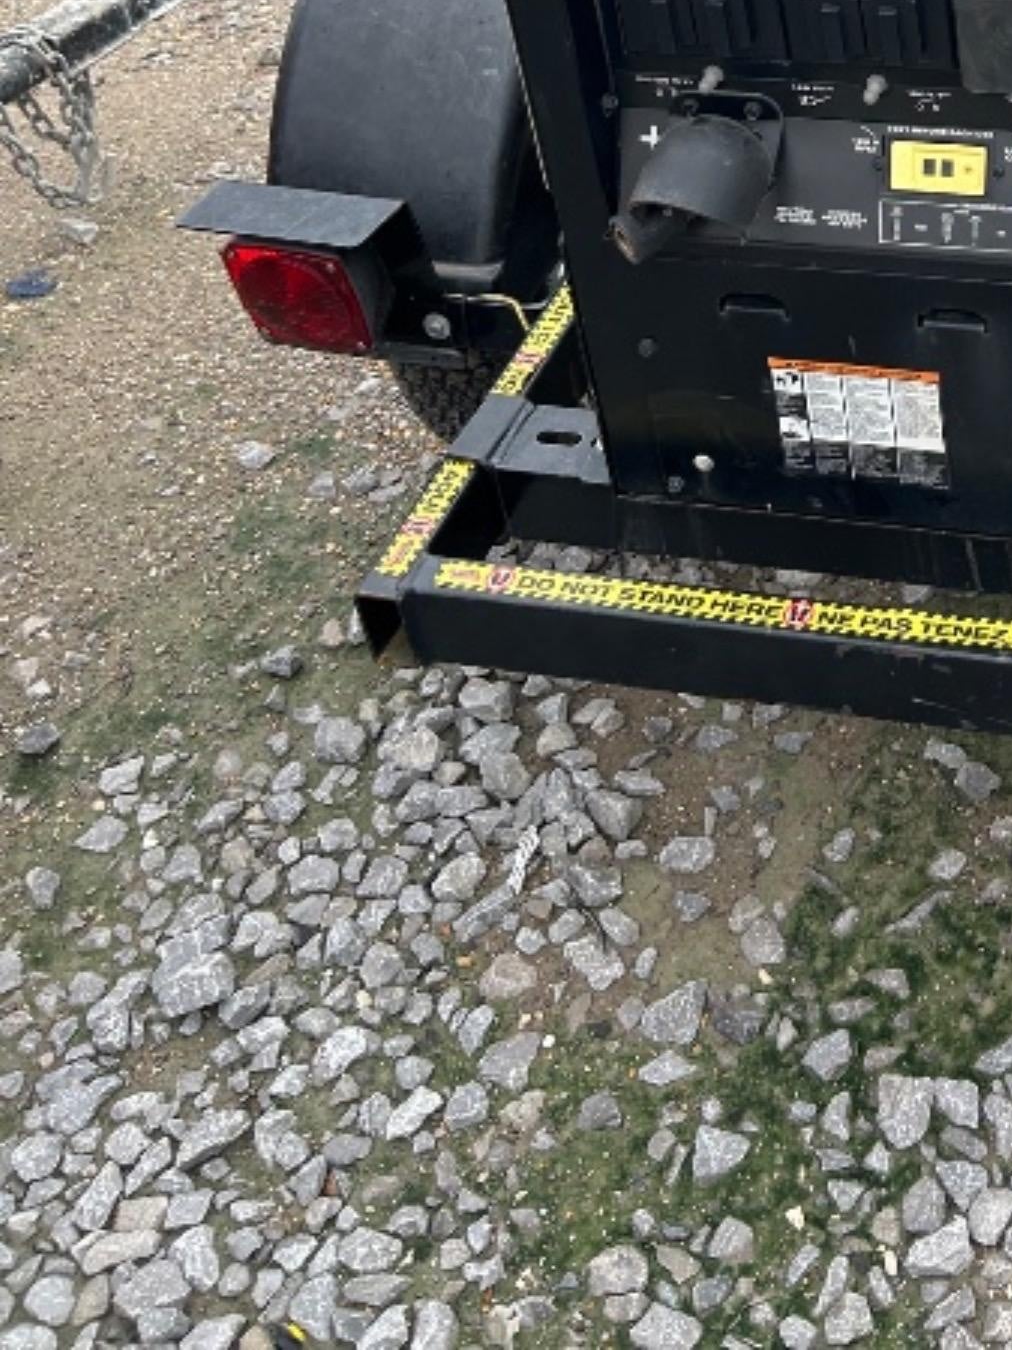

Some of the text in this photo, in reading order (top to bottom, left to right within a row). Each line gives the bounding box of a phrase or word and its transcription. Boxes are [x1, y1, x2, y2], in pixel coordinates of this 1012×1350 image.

[516, 575, 784, 620] DO NOT STAND HERE
[817, 607, 854, 627] NE
[859, 613, 913, 635] PAS
[920, 619, 1005, 643] TENEZ
